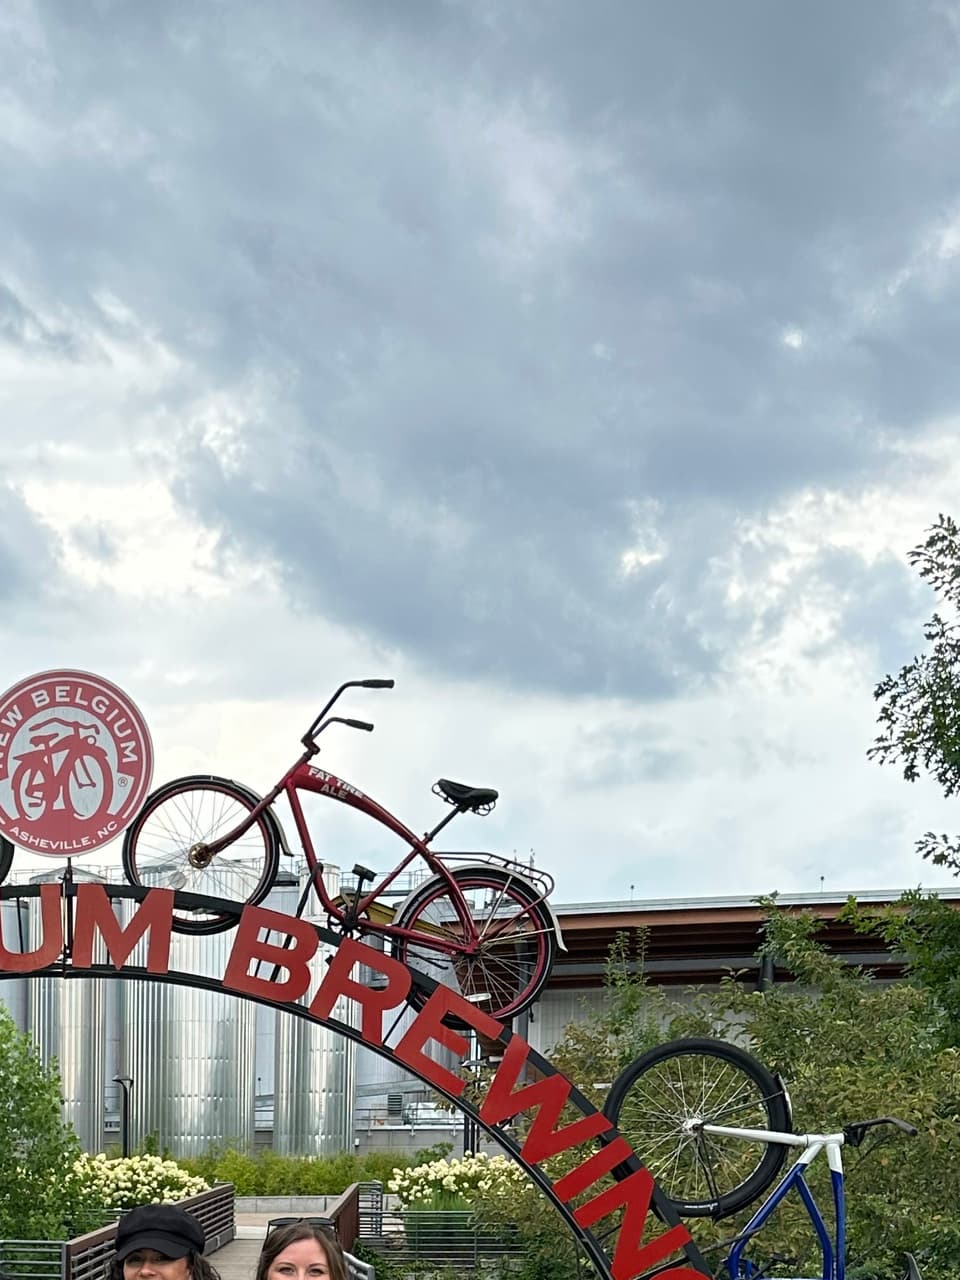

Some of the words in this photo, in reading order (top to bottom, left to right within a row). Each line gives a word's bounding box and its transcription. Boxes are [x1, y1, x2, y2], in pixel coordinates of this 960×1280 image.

[31, 686, 138, 763] BELGIUM
[309, 768, 333, 781] FAT
[321, 784, 348, 799] ALE
[9, 826, 96, 850] ASHEVILLE,
[97, 820, 118, 839] NC
